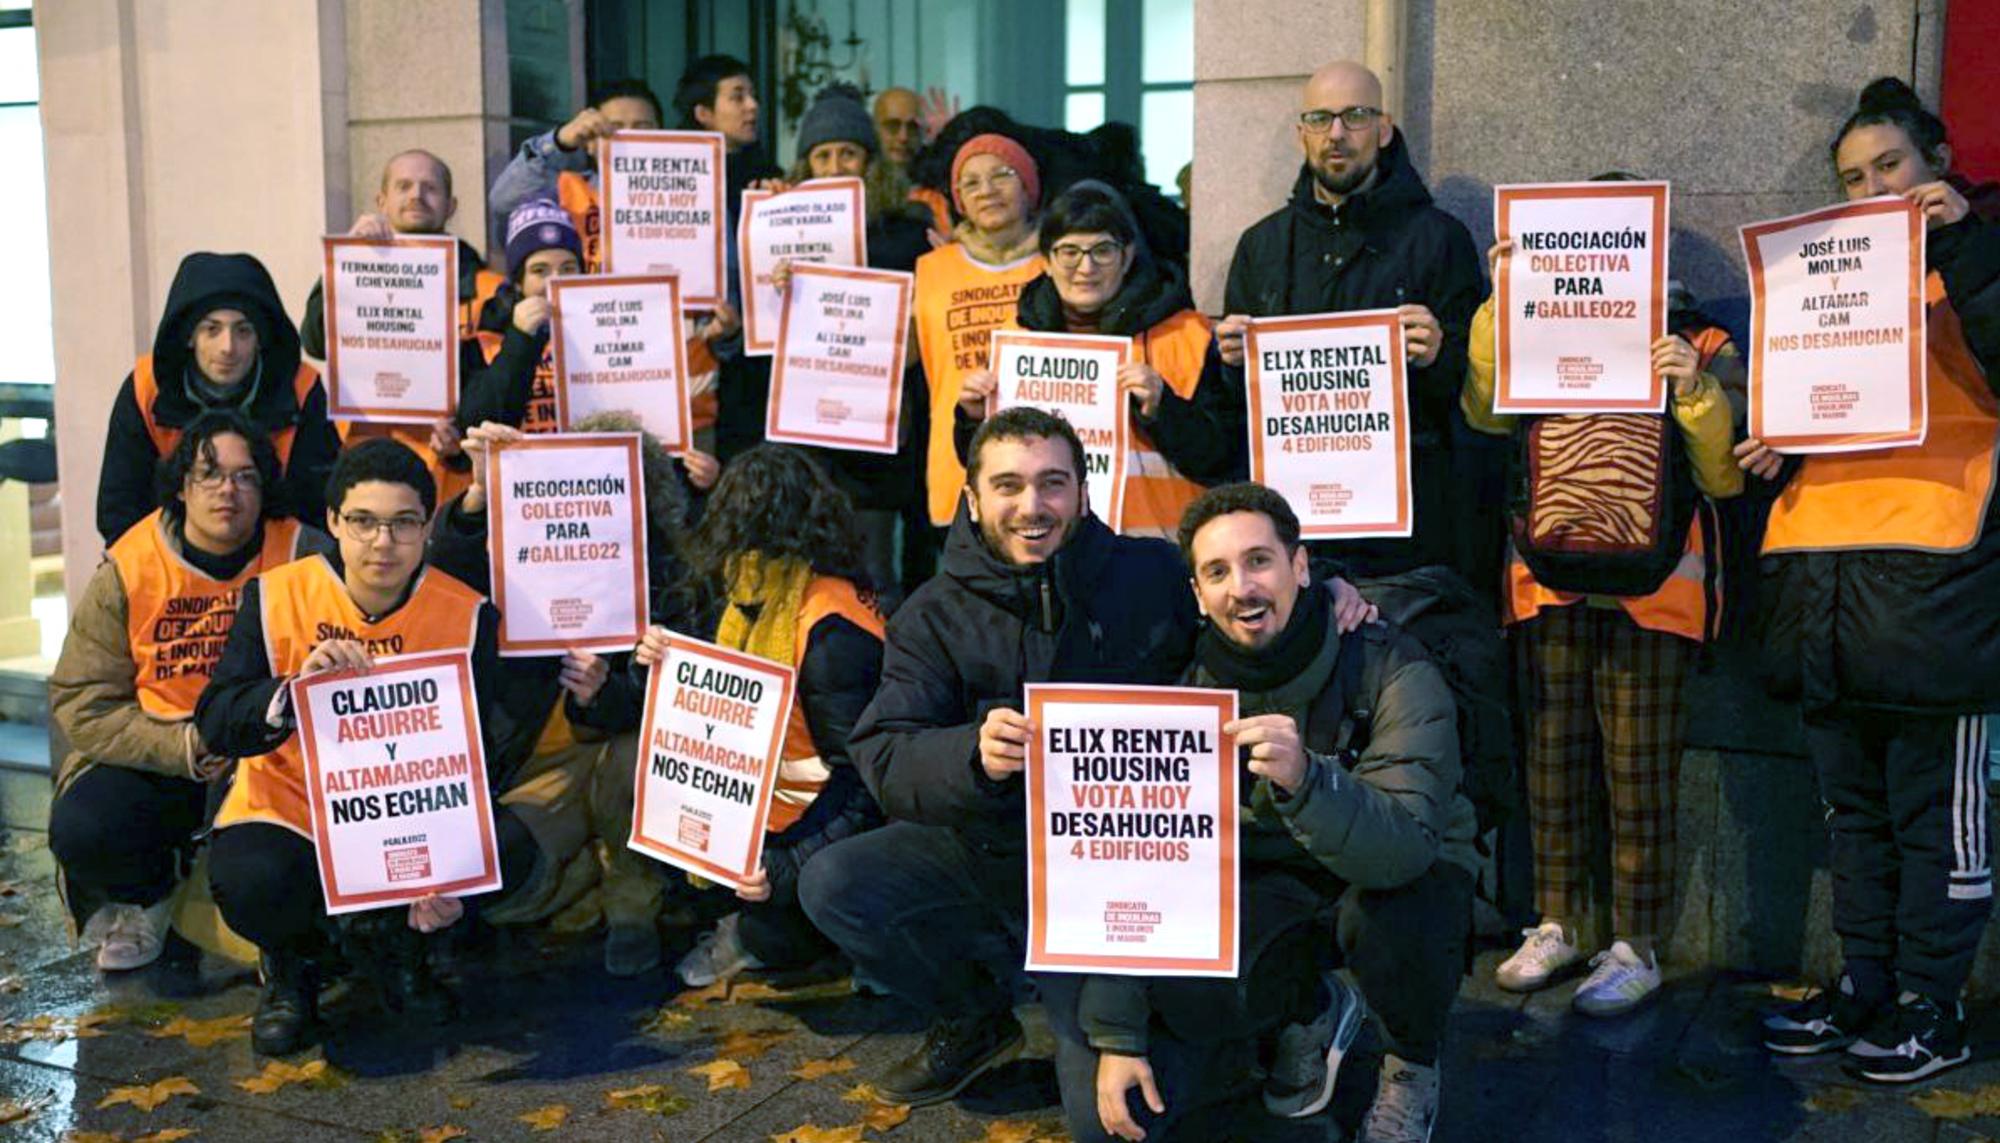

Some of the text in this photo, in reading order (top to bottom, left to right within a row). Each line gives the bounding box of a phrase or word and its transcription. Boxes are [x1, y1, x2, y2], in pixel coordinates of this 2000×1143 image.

[615, 157, 709, 174] ELIX RENTAL
[628, 176, 697, 191] HOUSING
[628, 193, 697, 207] VOTA HOY
[615, 210, 710, 225] DESAHUCIAR
[627, 227, 697, 239] 4 EDIFICIOS
[1522, 226, 1646, 250] NEGOCIACIÓN
[1799, 237, 1871, 258] JOSÉ LUIS
[342, 262, 438, 275] FERNANDO OLASO
[1531, 254, 1630, 272] COLECTIVA
[1808, 256, 1862, 275] MOLINA
[1555, 277, 1603, 295] PARA
[1831, 276, 1839, 290] Y
[387, 293, 394, 303] Y
[952, 284, 1019, 305] SINDICAT
[1802, 292, 1869, 311] ALTAMAR
[357, 306, 423, 319] ELIX RENTAL
[590, 300, 642, 313] JOSÉ LUIS
[367, 321, 415, 332] HOUSING
[596, 315, 638, 327] MOLINA
[1819, 312, 1850, 327] CAM
[341, 336, 442, 351] NOS DESAHUCIAN
[594, 341, 644, 354] ALTAMAR
[1769, 328, 1903, 352] NOS DESAHUCIAN
[608, 356, 632, 367] CAM
[1264, 345, 1386, 371] ELIX RENTAL
[570, 372, 593, 385] NOS
[596, 369, 671, 384] DESAHUCIAN
[814, 360, 887, 378] DESAHUCIAN
[1017, 355, 1099, 381] CLAUDIO
[1282, 369, 1370, 393] HOUSING
[1015, 380, 1098, 404] AGUIRRE
[1282, 391, 1371, 413] VOTA HOY
[1267, 413, 1390, 436] DESAHUCIAR
[1282, 435, 1372, 453] 4 EDIFICIOS
[513, 474, 625, 498] NEGOCIACIÓN
[521, 500, 613, 520] COLECTIVA
[546, 522, 590, 540] PARA
[677, 661, 763, 703] CLAUDIO
[331, 679, 438, 715] CLAUDIO
[673, 687, 758, 729] AGUIRRE
[338, 706, 442, 743] AGUIRRE
[705, 724, 714, 739] Y
[1050, 728, 1212, 753] ELIX RENTAL
[385, 743, 397, 761] Y
[654, 728, 763, 777] ALTAMARCAM
[326, 754, 468, 794] ALTAMARCAM
[1073, 757, 1190, 781] HOUSING
[652, 753, 755, 806] NOS ECHAN
[332, 782, 468, 824] NOS ECHAN
[1072, 785, 1191, 809] VOTA HOY
[1051, 813, 1213, 838] DESAHUCIAR
[1071, 840, 1190, 861] 4 EDIFICIOS
[1106, 901, 1147, 910] SINDICATO
